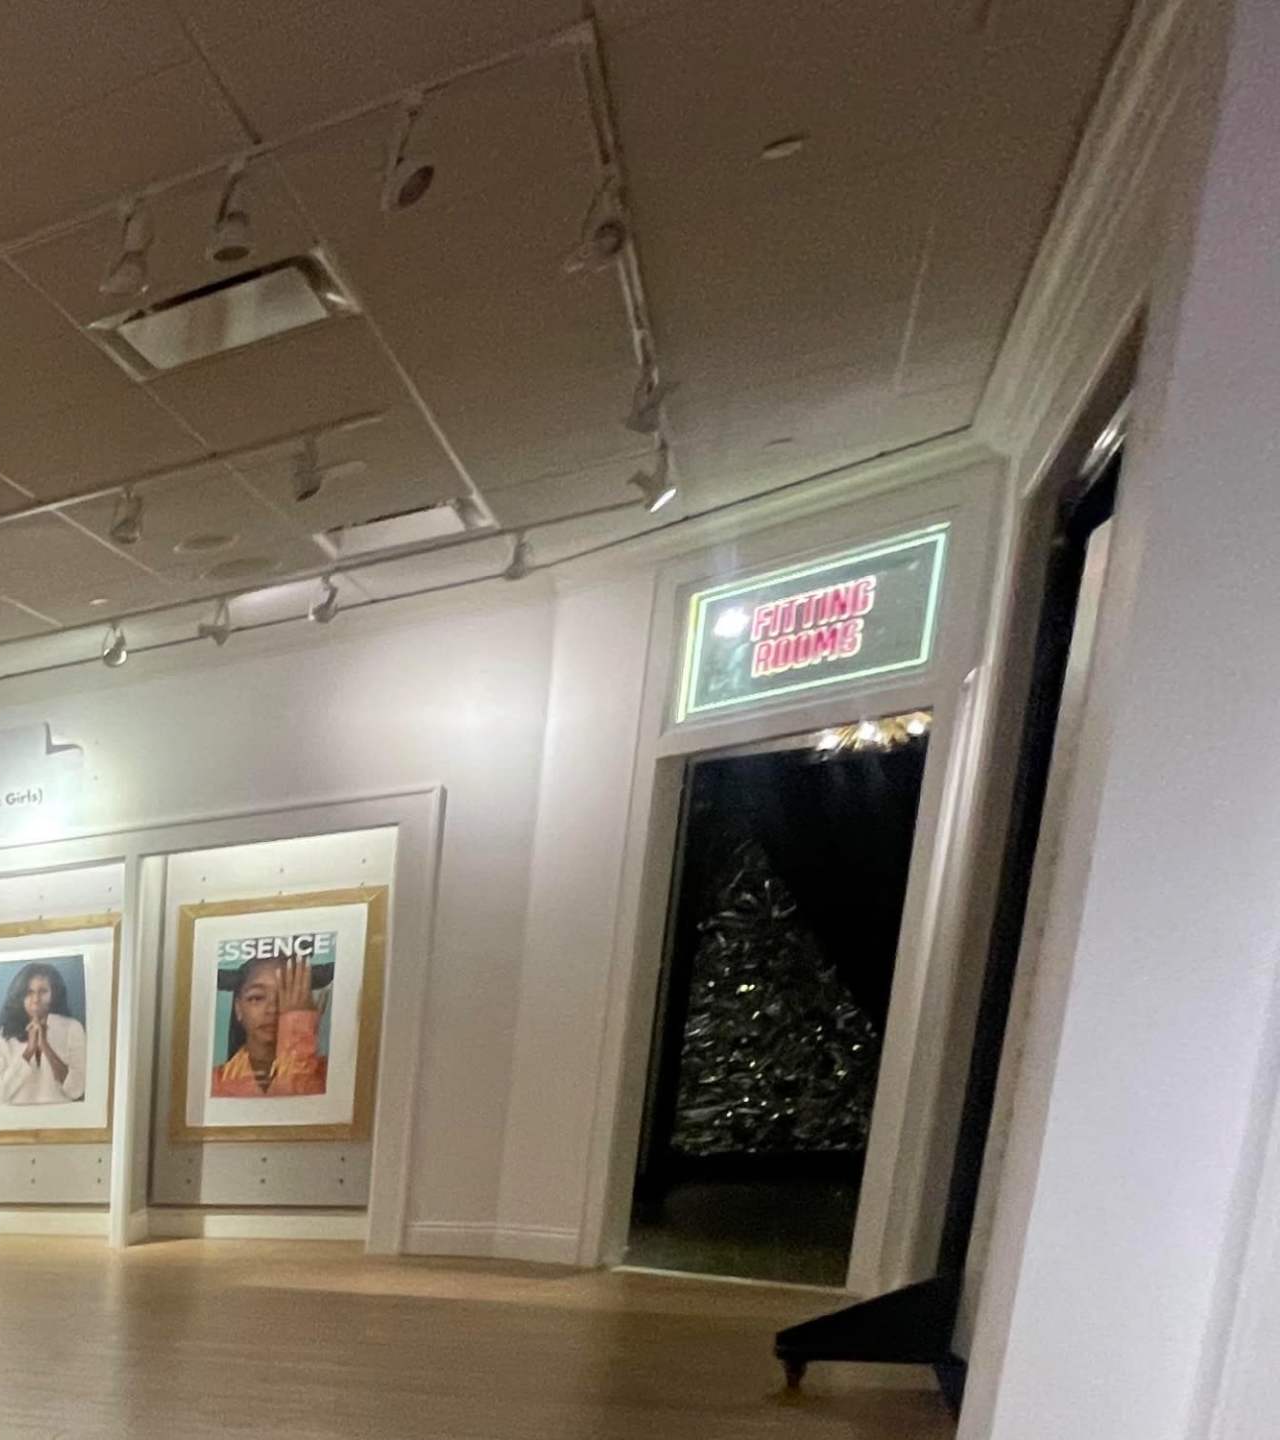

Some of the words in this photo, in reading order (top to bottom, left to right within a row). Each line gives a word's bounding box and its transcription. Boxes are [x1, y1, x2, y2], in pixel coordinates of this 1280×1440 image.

[750, 575, 876, 642] FITTING
[751, 617, 865, 678] ROOMS
[5, 788, 43, 806] Girls)
